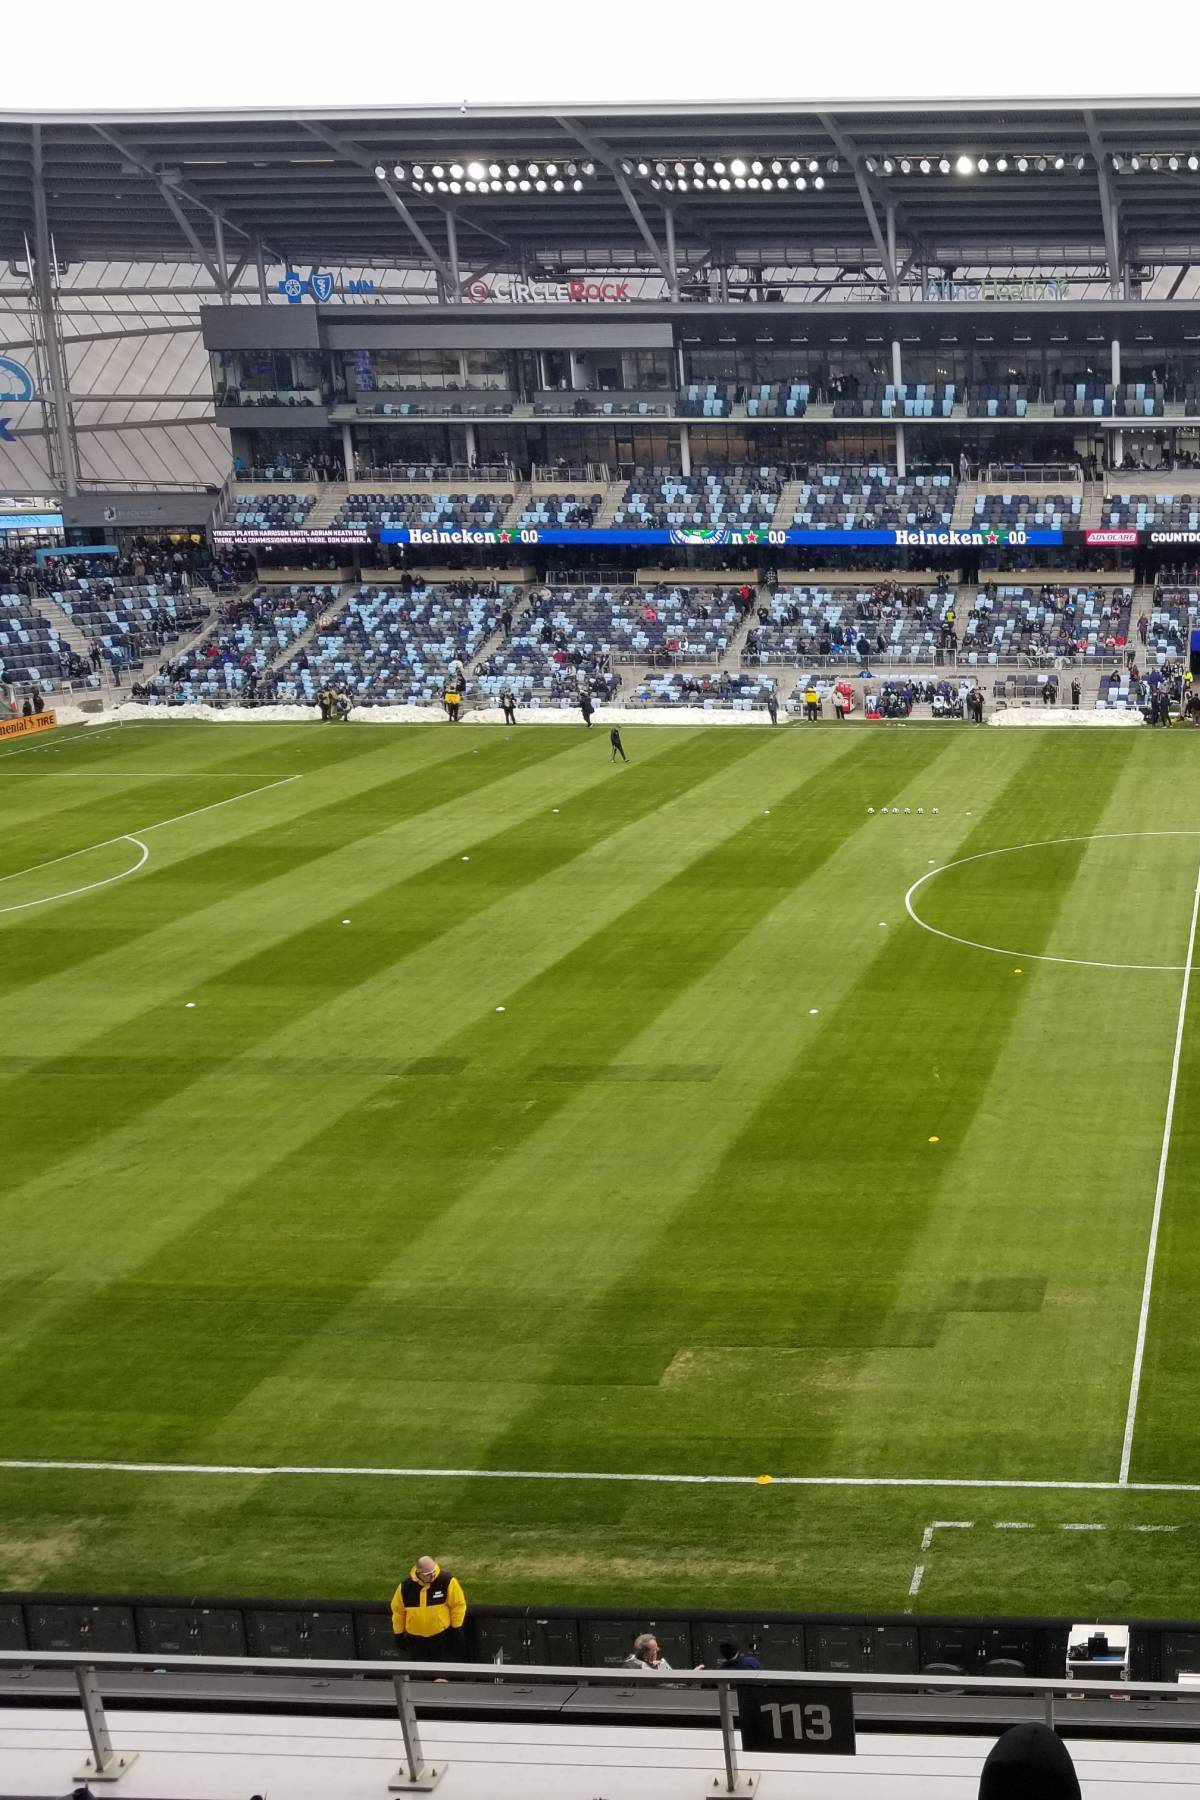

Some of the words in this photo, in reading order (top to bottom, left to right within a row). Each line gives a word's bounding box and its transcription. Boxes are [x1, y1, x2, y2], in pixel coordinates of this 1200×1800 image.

[409, 529, 496, 544] Heineken
[895, 530, 984, 545] Heineken
[1088, 533, 1135, 542] ADVOCARE
[37, 714, 55, 727] TIRE
[760, 1702, 832, 1741] 113
